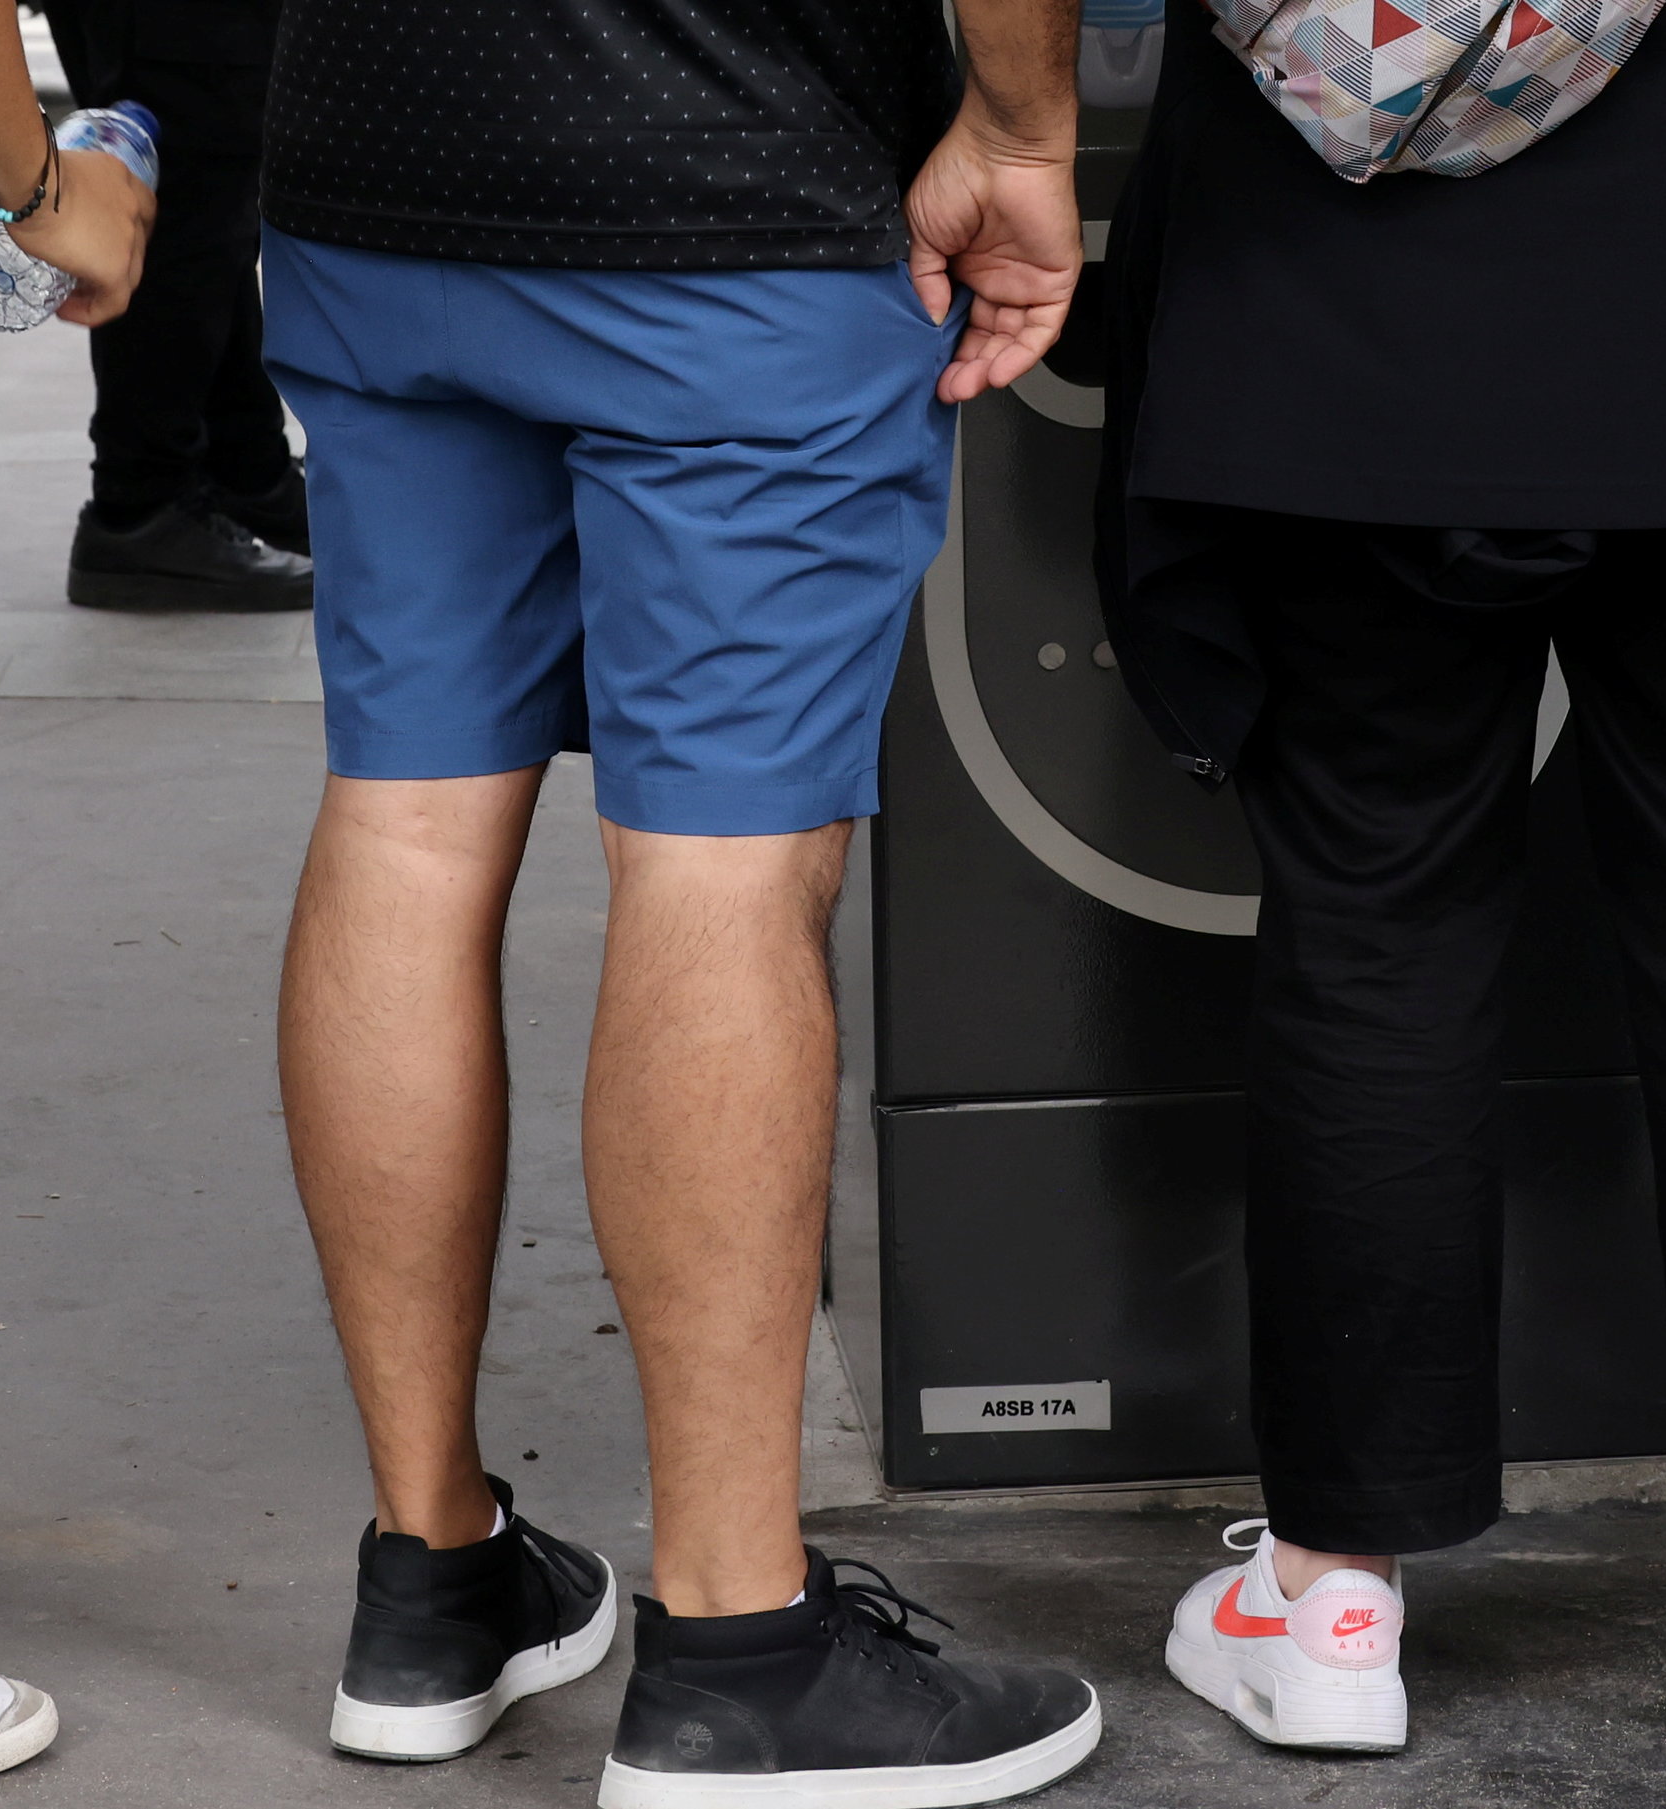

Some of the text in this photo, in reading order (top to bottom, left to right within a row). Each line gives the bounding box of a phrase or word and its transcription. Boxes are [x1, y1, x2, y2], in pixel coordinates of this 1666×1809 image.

[981, 1399, 1076, 1417] A8SB 17A
[1340, 1608, 1375, 1625] NIKE
[1339, 1640, 1375, 1651] AIR
